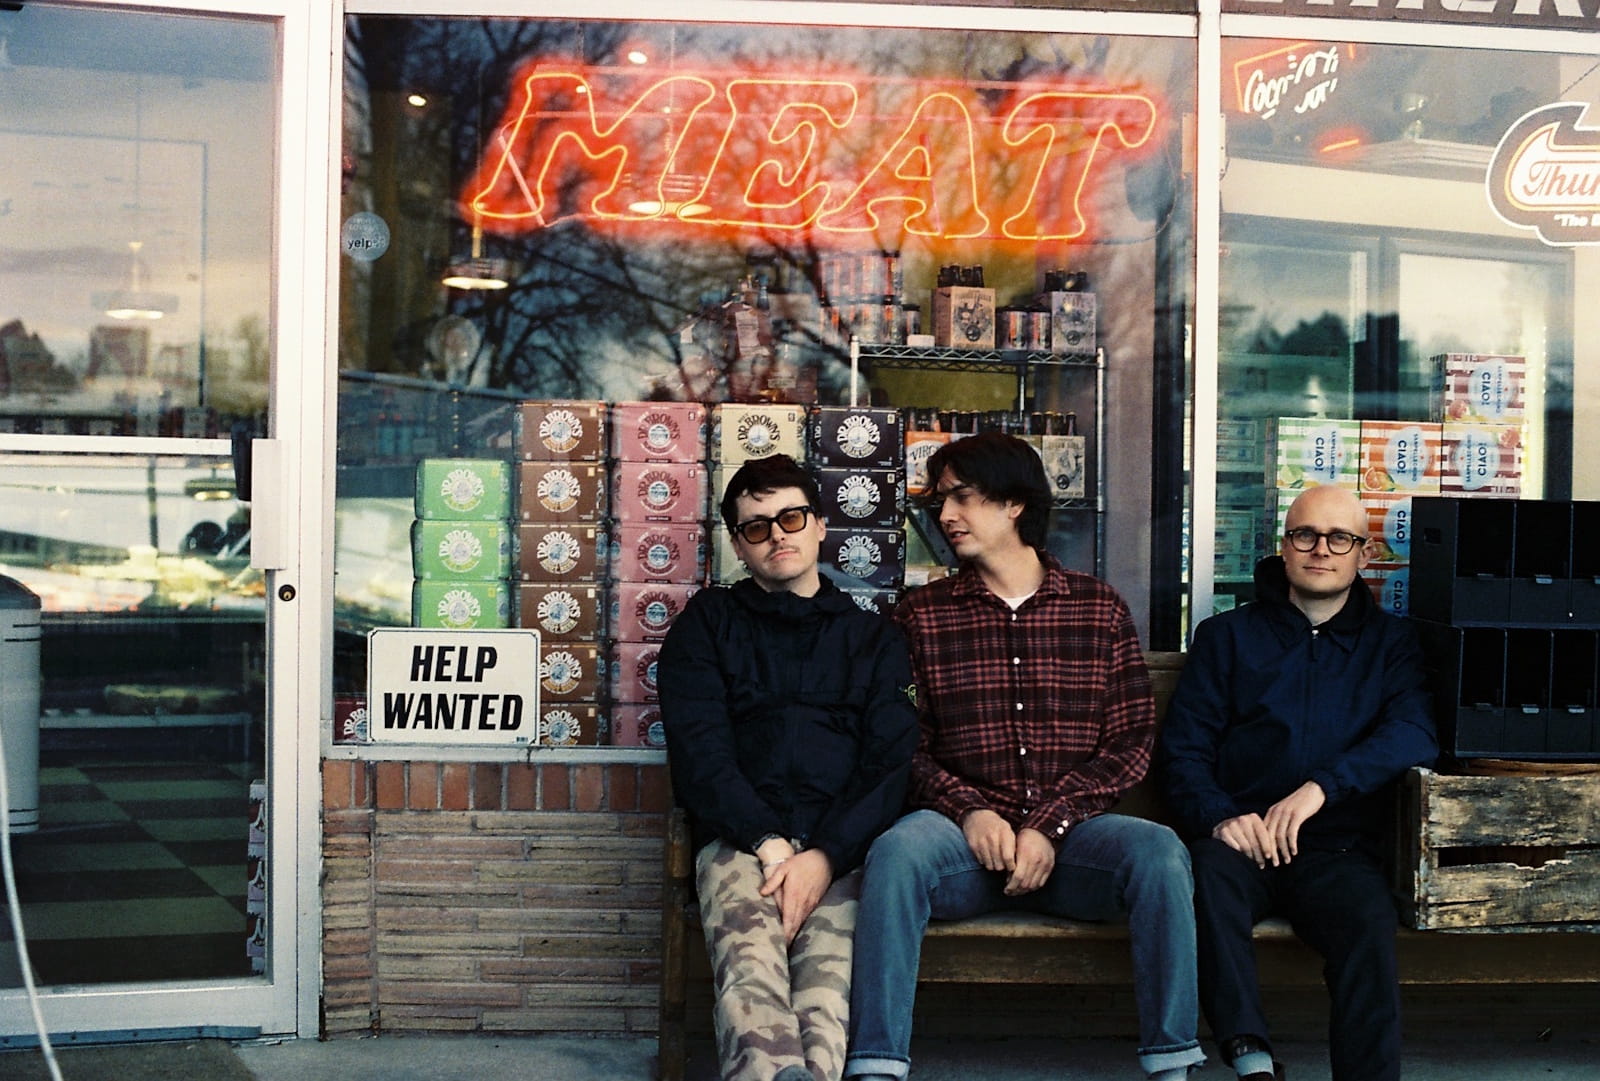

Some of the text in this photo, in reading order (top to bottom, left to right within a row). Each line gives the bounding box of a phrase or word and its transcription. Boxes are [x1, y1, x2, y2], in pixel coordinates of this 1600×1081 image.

[472, 73, 1157, 239] MEAT
[347, 238, 373, 250] yelp
[1481, 371, 1491, 405] CIAO!
[1314, 437, 1325, 472] CIAO!
[1397, 440, 1408, 474] CIAO!
[1477, 442, 1487, 476] CIAO!
[1396, 510, 1406, 544] CIAO!
[410, 645, 498, 682] HELP
[384, 692, 523, 730] WANTED
